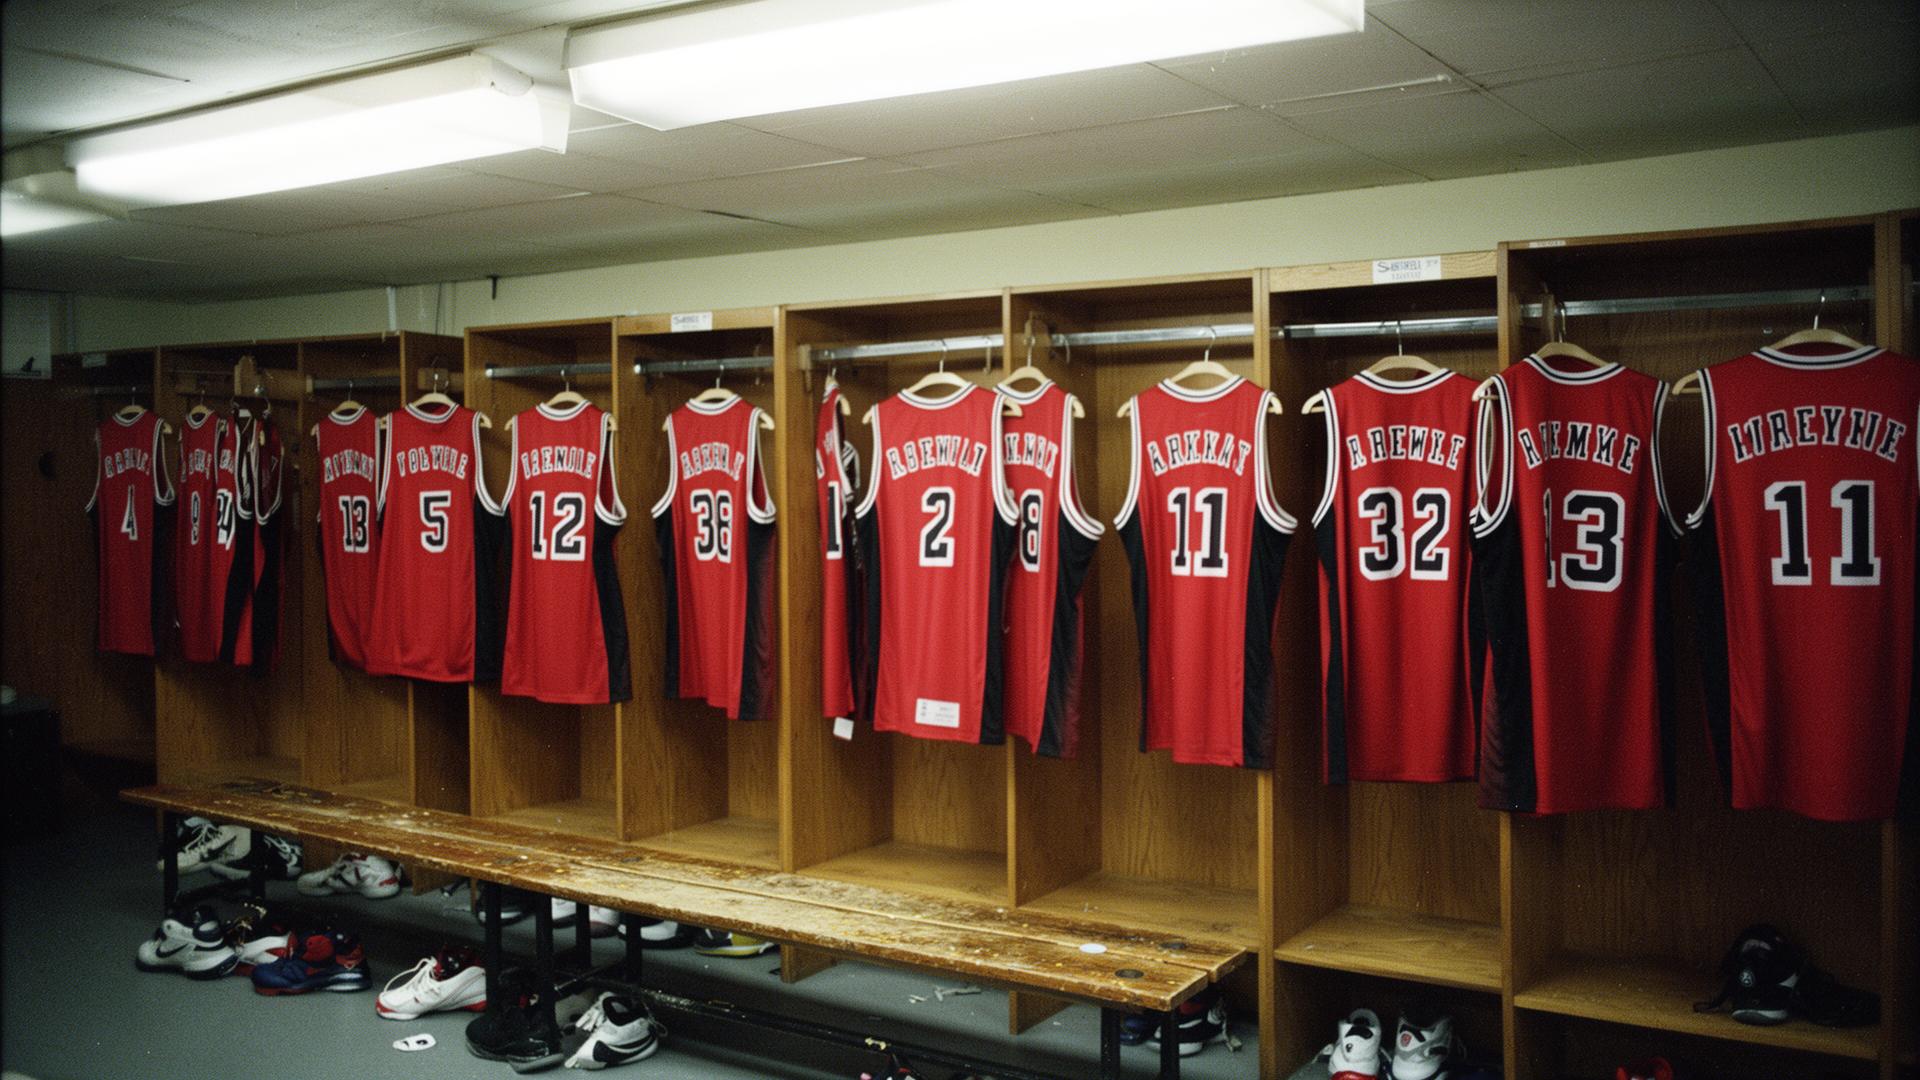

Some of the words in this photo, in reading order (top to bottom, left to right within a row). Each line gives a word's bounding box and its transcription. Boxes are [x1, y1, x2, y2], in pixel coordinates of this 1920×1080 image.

[120, 483, 138, 541] 4
[339, 496, 370, 553] 13
[419, 490, 451, 553] 5
[530, 490, 586, 561] 12
[919, 487, 955, 567] 2
[1168, 486, 1228, 578] 11
[1358, 486, 1450, 581] 32
[1543, 488, 1626, 592] 13
[1764, 480, 1882, 586] 11
